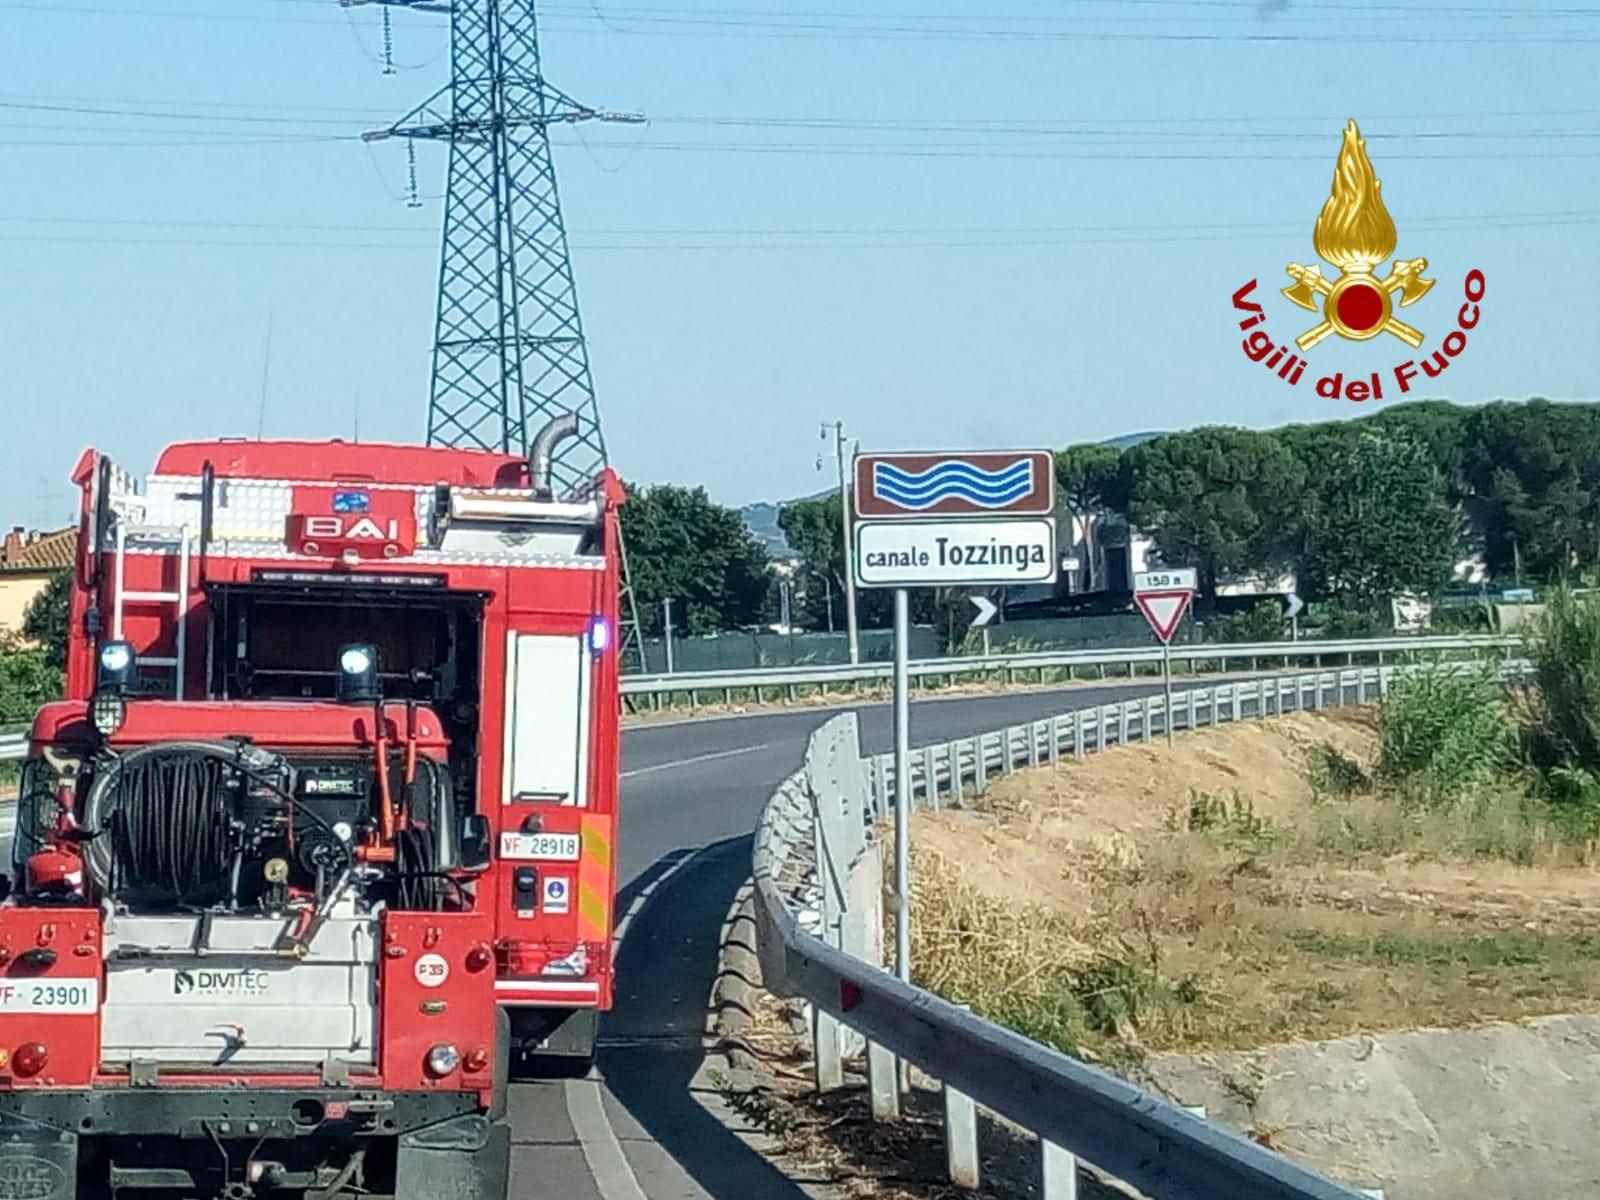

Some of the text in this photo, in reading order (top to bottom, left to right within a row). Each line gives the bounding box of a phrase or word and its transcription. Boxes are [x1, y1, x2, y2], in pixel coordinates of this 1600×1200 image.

[306, 517, 398, 540] BAI
[865, 537, 1045, 571] canale Tozzinga
[503, 837, 576, 855] VF 28918
[31, 986, 88, 1006] 23901
